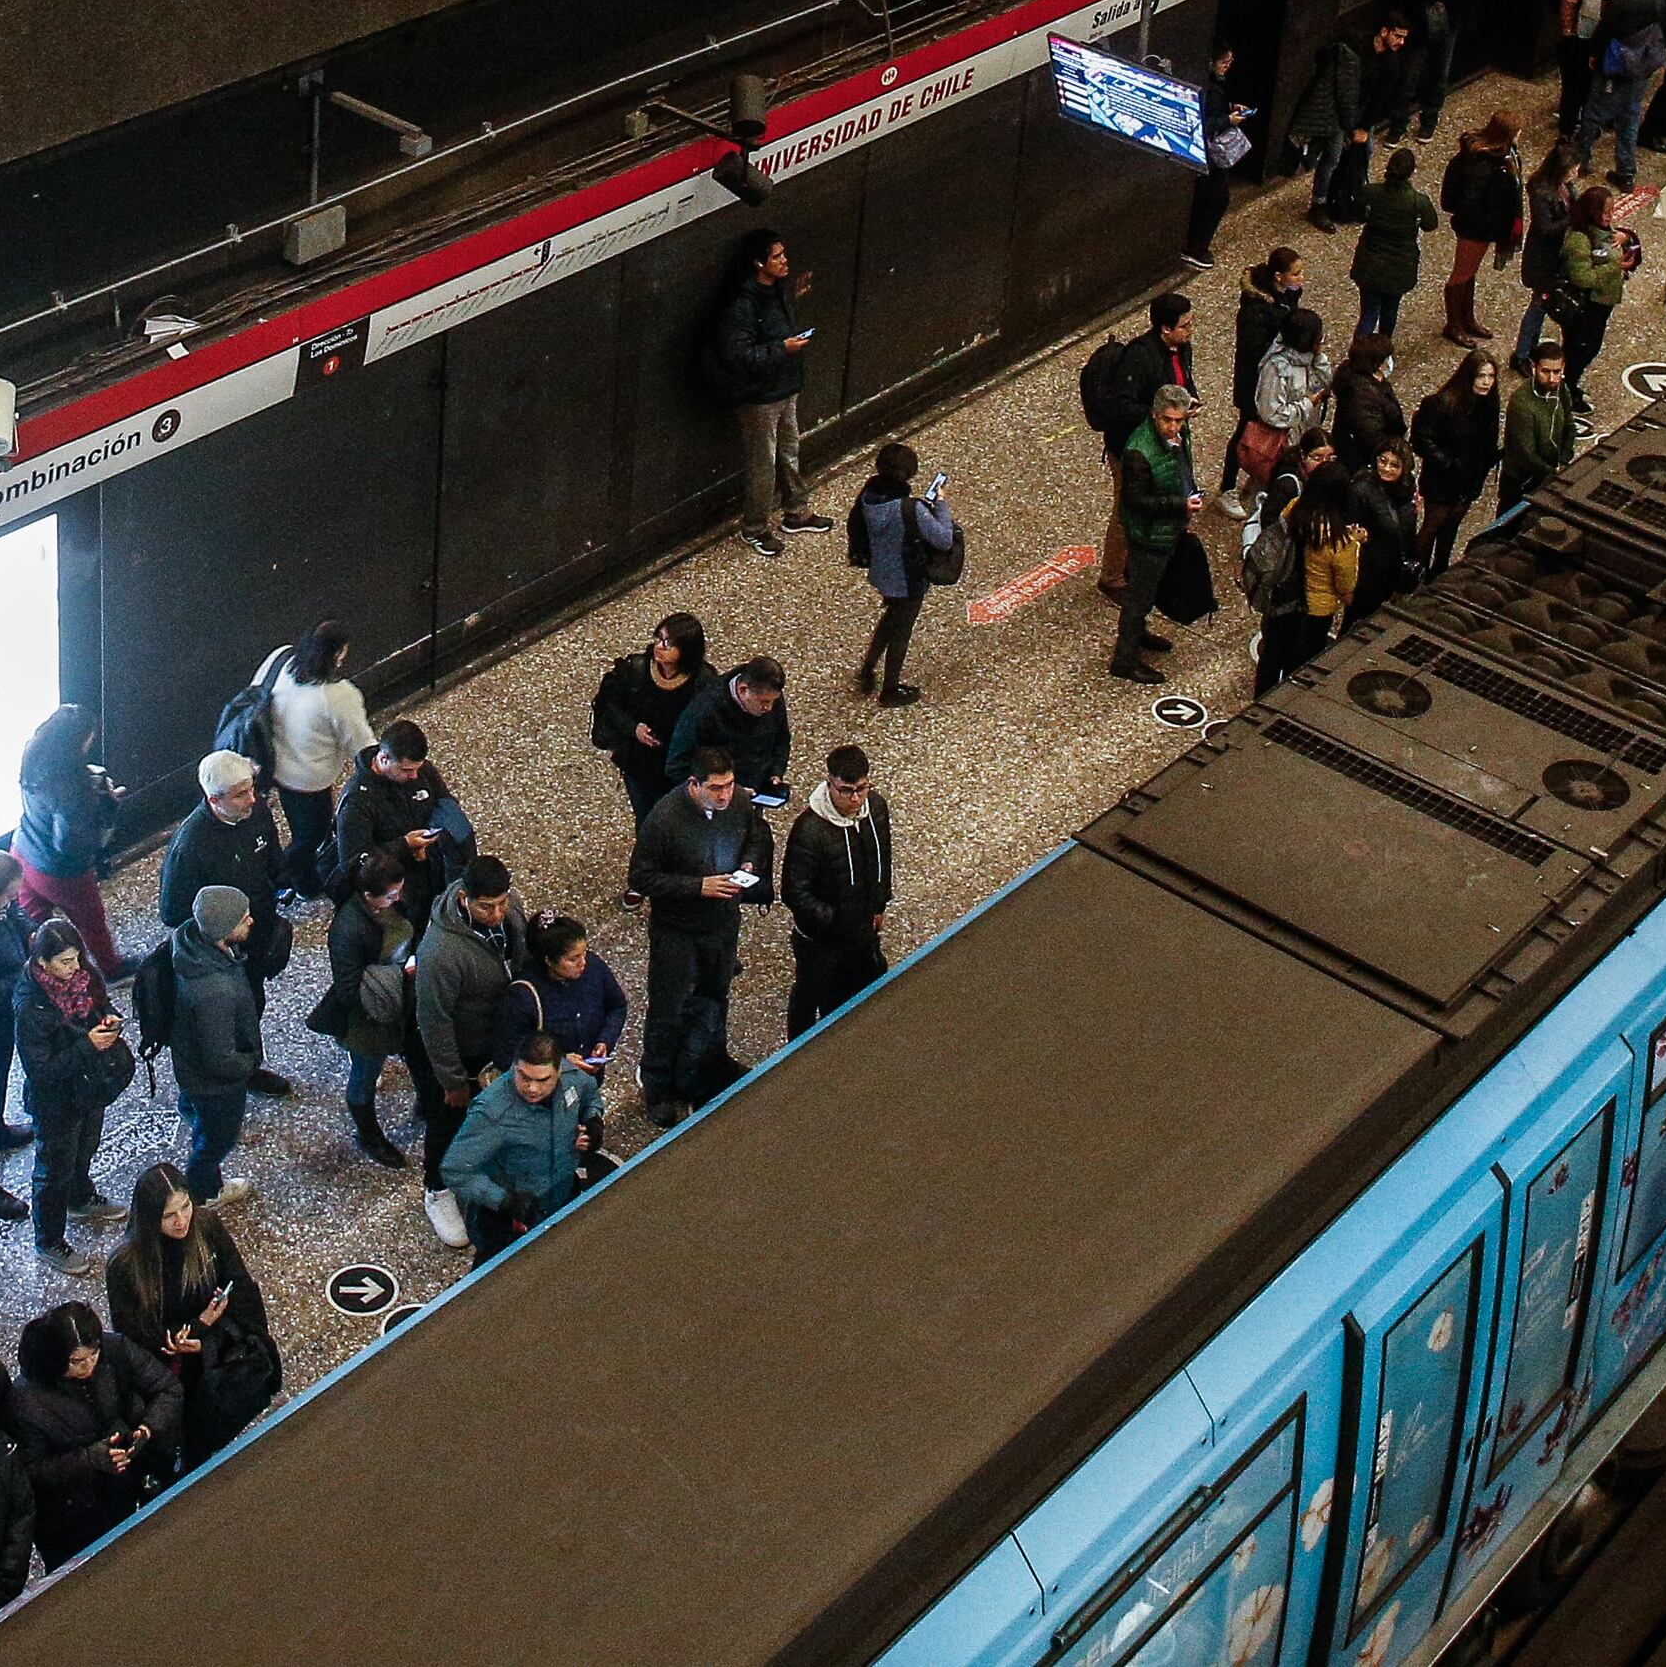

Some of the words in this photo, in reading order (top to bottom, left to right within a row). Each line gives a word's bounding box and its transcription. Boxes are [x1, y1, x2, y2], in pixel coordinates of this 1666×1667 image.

[1091, 0, 1131, 29] Salida
[888, 94, 915, 123] DE
[920, 67, 975, 109] CHILE
